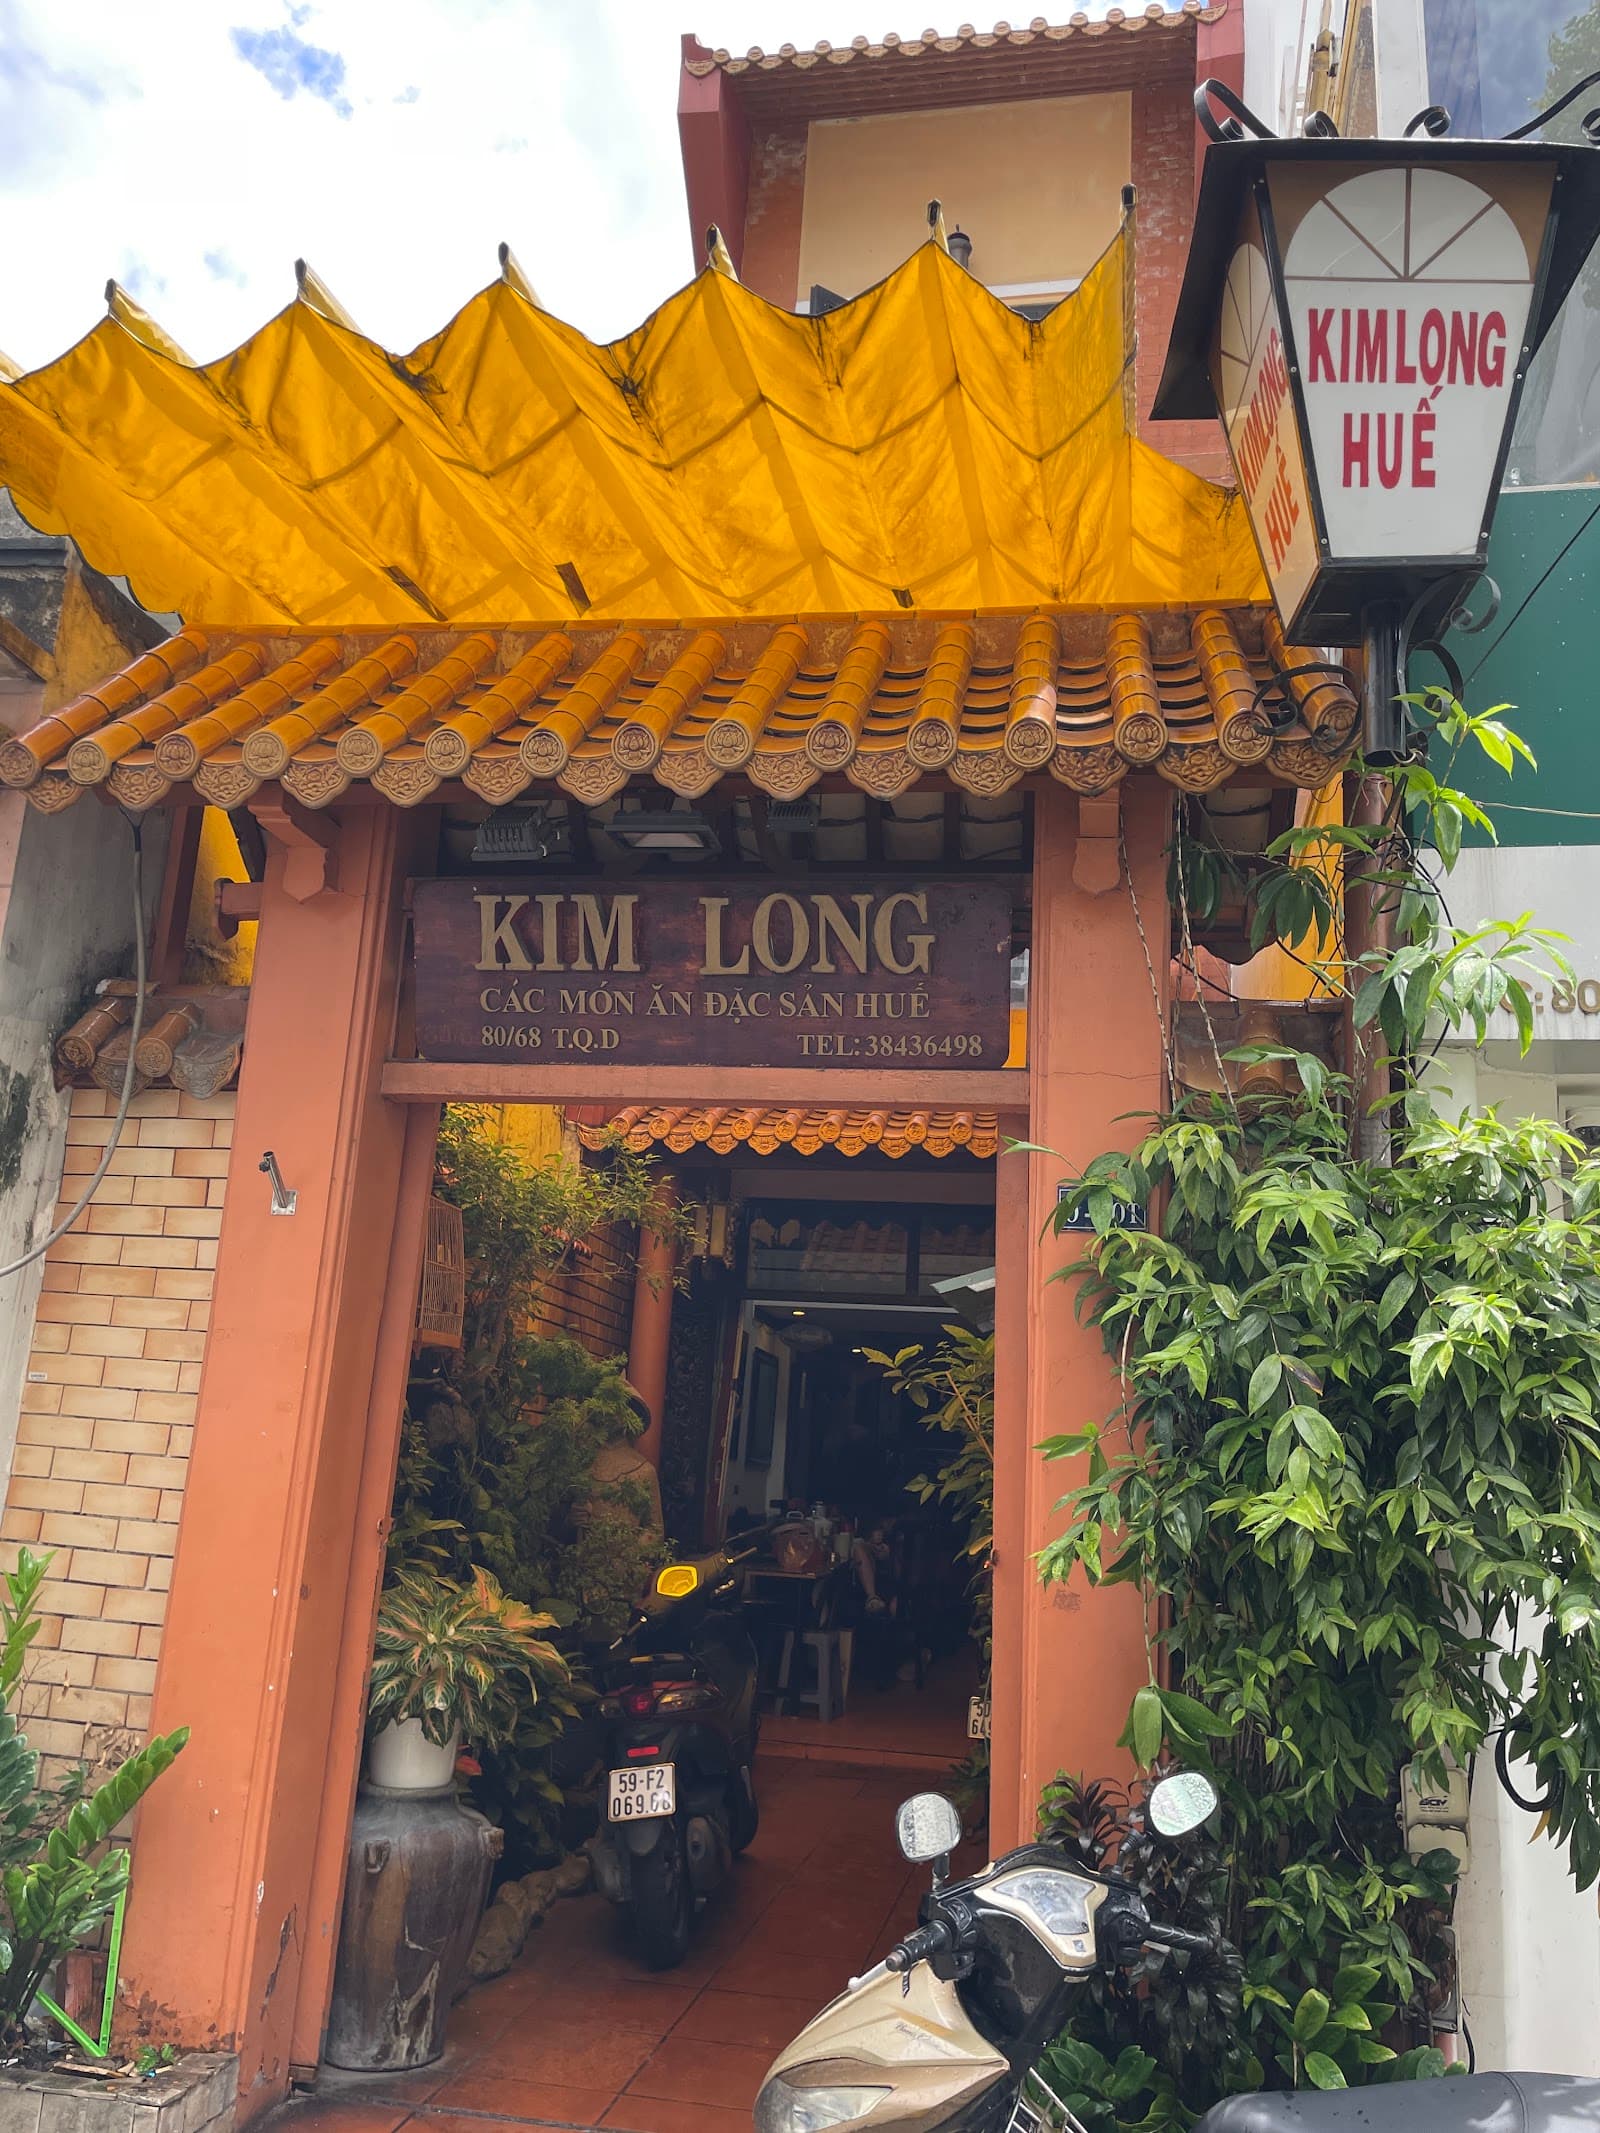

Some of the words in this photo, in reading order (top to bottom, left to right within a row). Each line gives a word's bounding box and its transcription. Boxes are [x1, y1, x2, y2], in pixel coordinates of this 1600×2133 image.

[1342, 386, 1443, 489] HUẾ
[1265, 423, 1299, 574] HUẾ
[473, 894, 641, 971] KIM
[699, 892, 936, 975] LONG
[479, 979, 545, 1013] CÁC
[559, 981, 635, 1015] MÓN
[646, 984, 693, 1016] ĂN
[704, 987, 770, 1023] ĐẶC
[779, 983, 843, 1017] SẢN
[854, 982, 930, 1018] HUẾ
[481, 1025, 542, 1048] 80/68
[552, 1028, 620, 1053] T.Q.D
[619, 1769, 665, 1793] 59-F2
